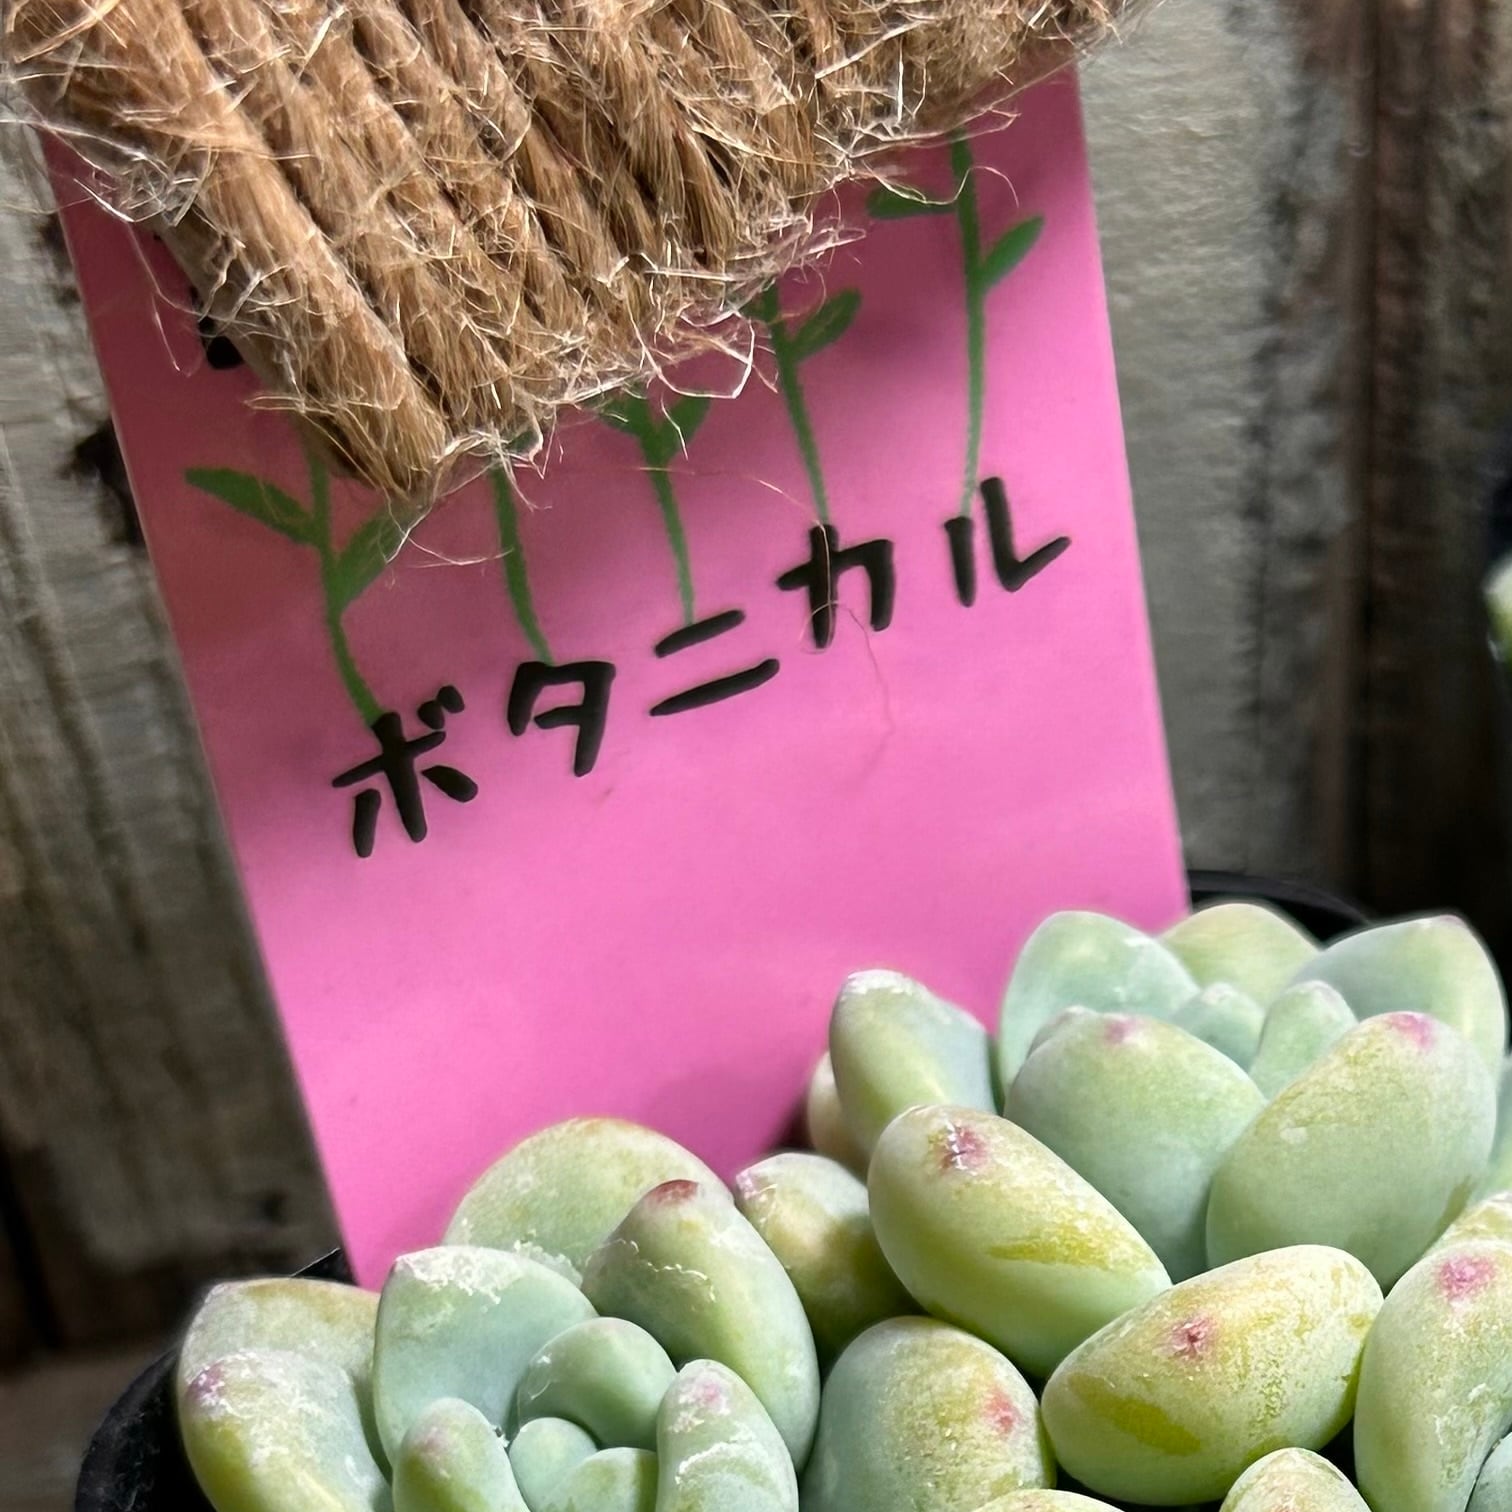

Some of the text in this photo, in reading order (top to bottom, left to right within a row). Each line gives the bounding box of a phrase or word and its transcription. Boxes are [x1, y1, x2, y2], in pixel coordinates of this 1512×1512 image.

[332, 477, 1071, 858] ボタニカル
